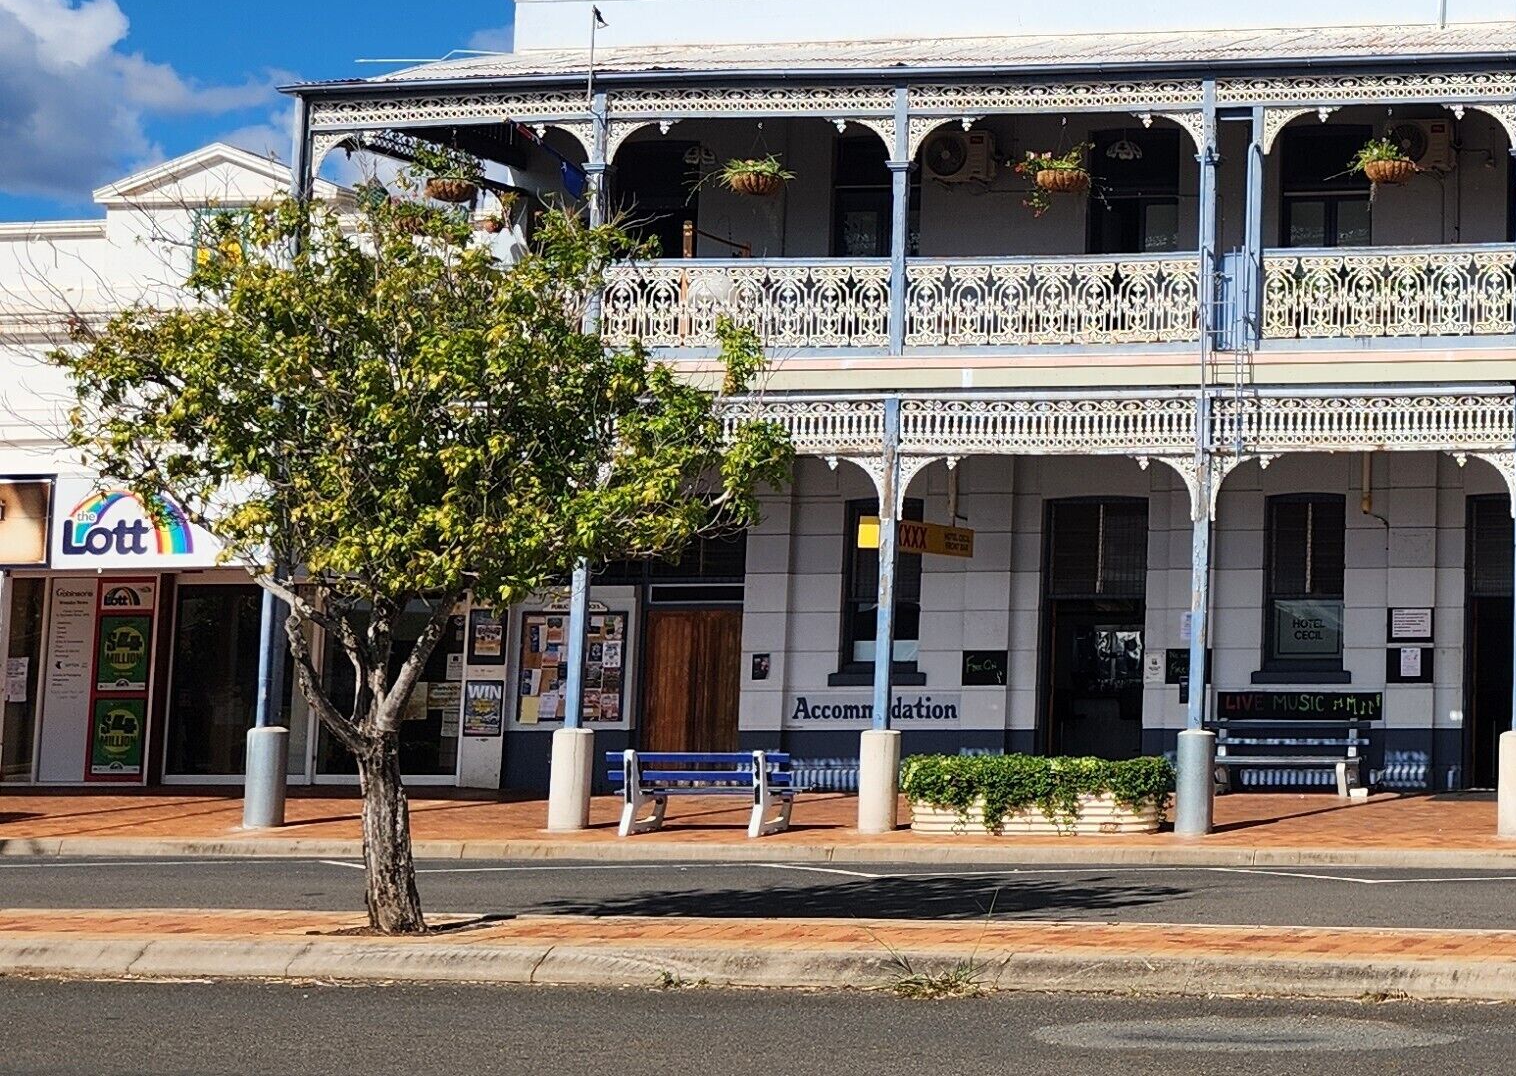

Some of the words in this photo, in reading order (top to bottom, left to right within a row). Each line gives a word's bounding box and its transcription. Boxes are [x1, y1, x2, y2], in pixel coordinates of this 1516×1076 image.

[77, 510, 96, 522] the
[62, 519, 150, 556] Lott
[1292, 618, 1326, 629] HOTEL
[1294, 630, 1324, 640] CECIL
[468, 685, 502, 700] WIN
[791, 696, 958, 720] Accommdation
[1226, 694, 1264, 711] LIVE
[1273, 694, 1325, 712] MUSIC
